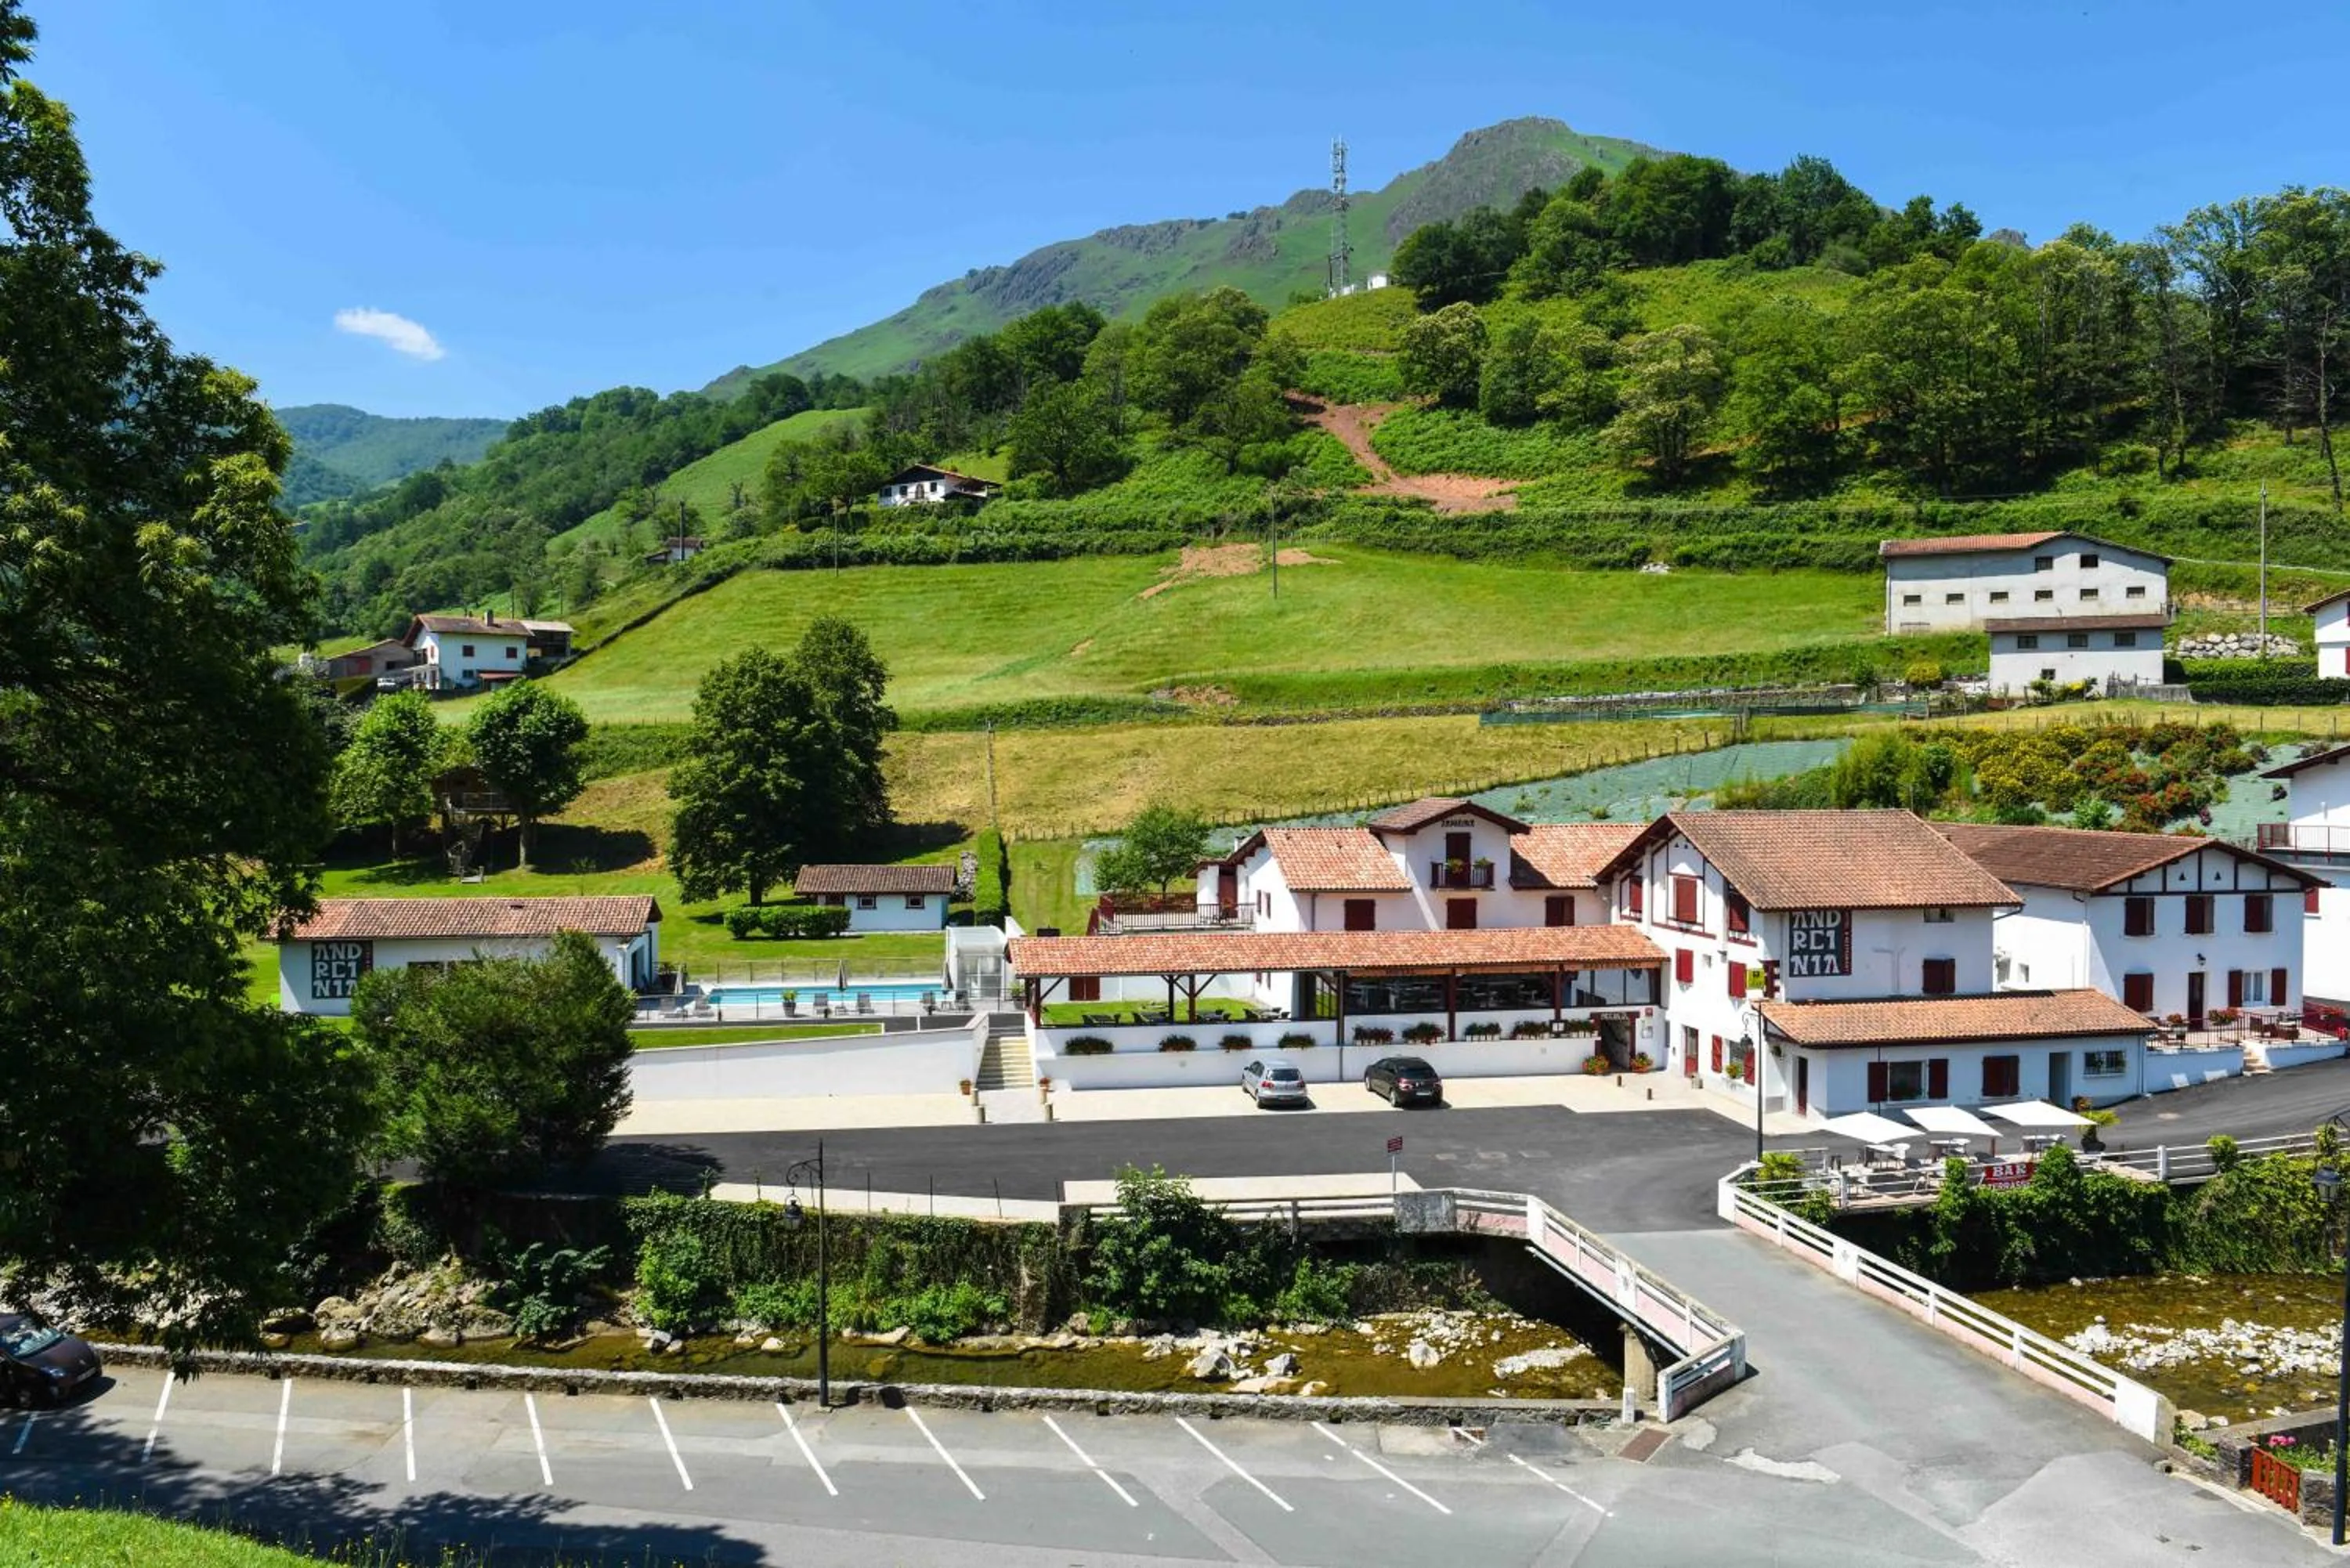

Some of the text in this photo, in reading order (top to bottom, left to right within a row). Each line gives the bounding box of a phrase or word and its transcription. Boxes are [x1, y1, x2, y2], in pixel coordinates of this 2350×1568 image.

[1792, 910, 1842, 928] AND
[314, 943, 363, 960] AND
[1993, 1164, 2026, 1177] BAR
